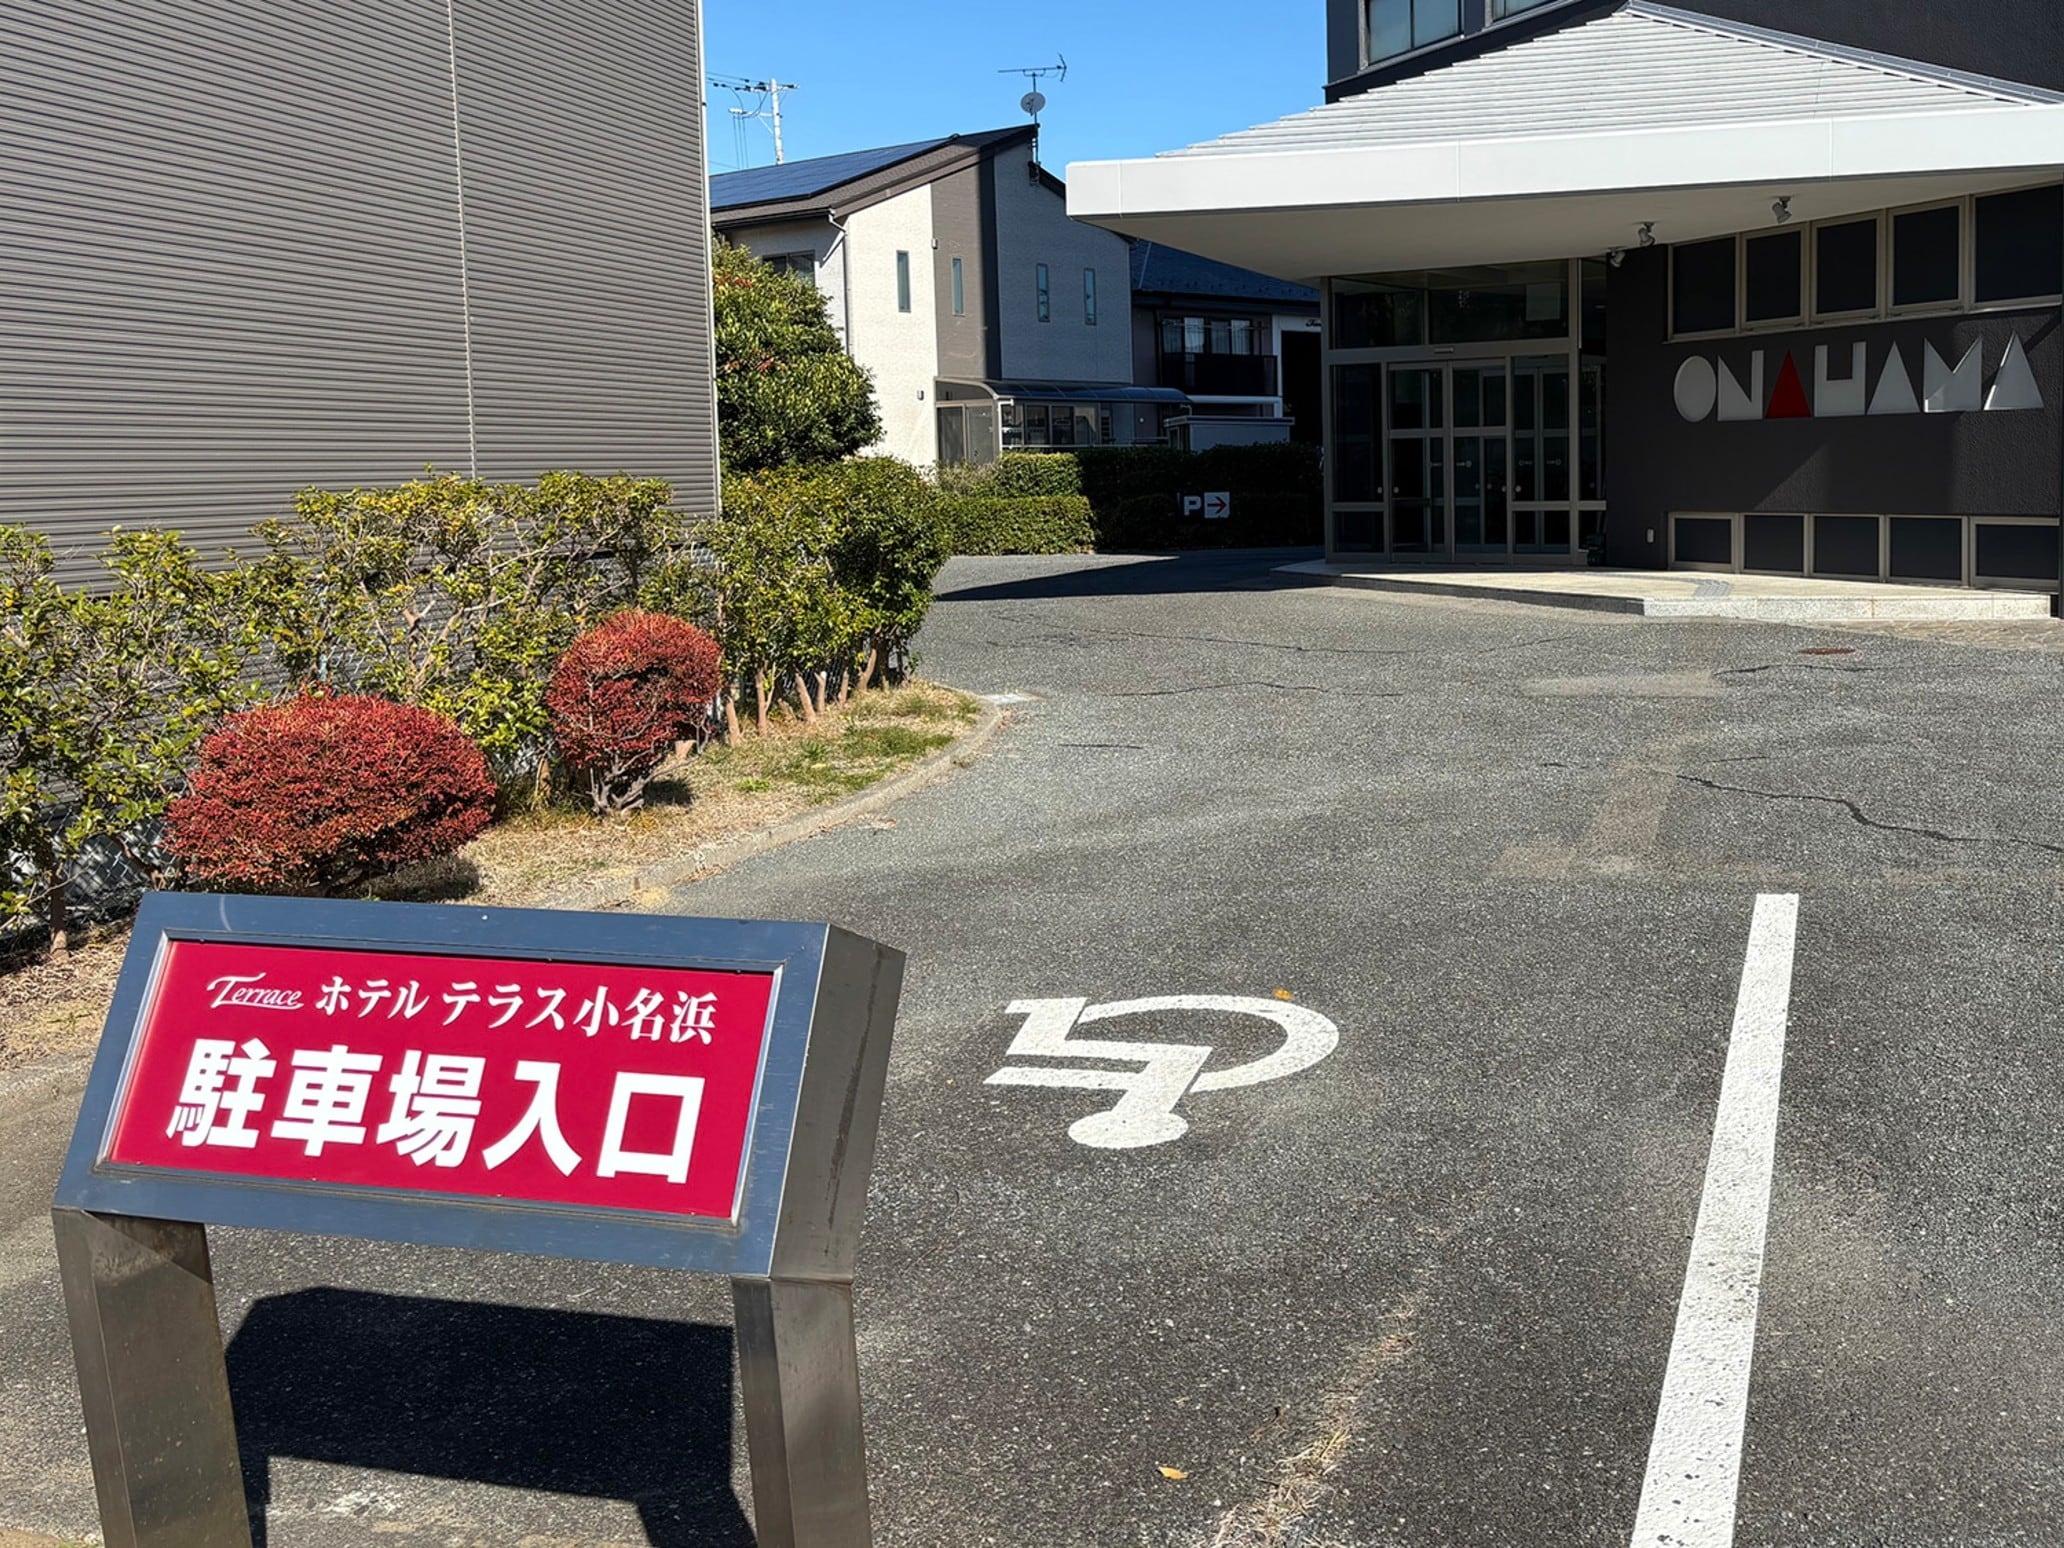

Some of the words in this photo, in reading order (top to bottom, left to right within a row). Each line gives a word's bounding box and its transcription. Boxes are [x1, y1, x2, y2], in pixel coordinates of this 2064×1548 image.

[1673, 330, 2044, 423] ONAHAMA
[1184, 495, 1202, 516] P
[206, 972, 304, 1010] Terrace
[165, 1037, 706, 1184] 駐車場入口
